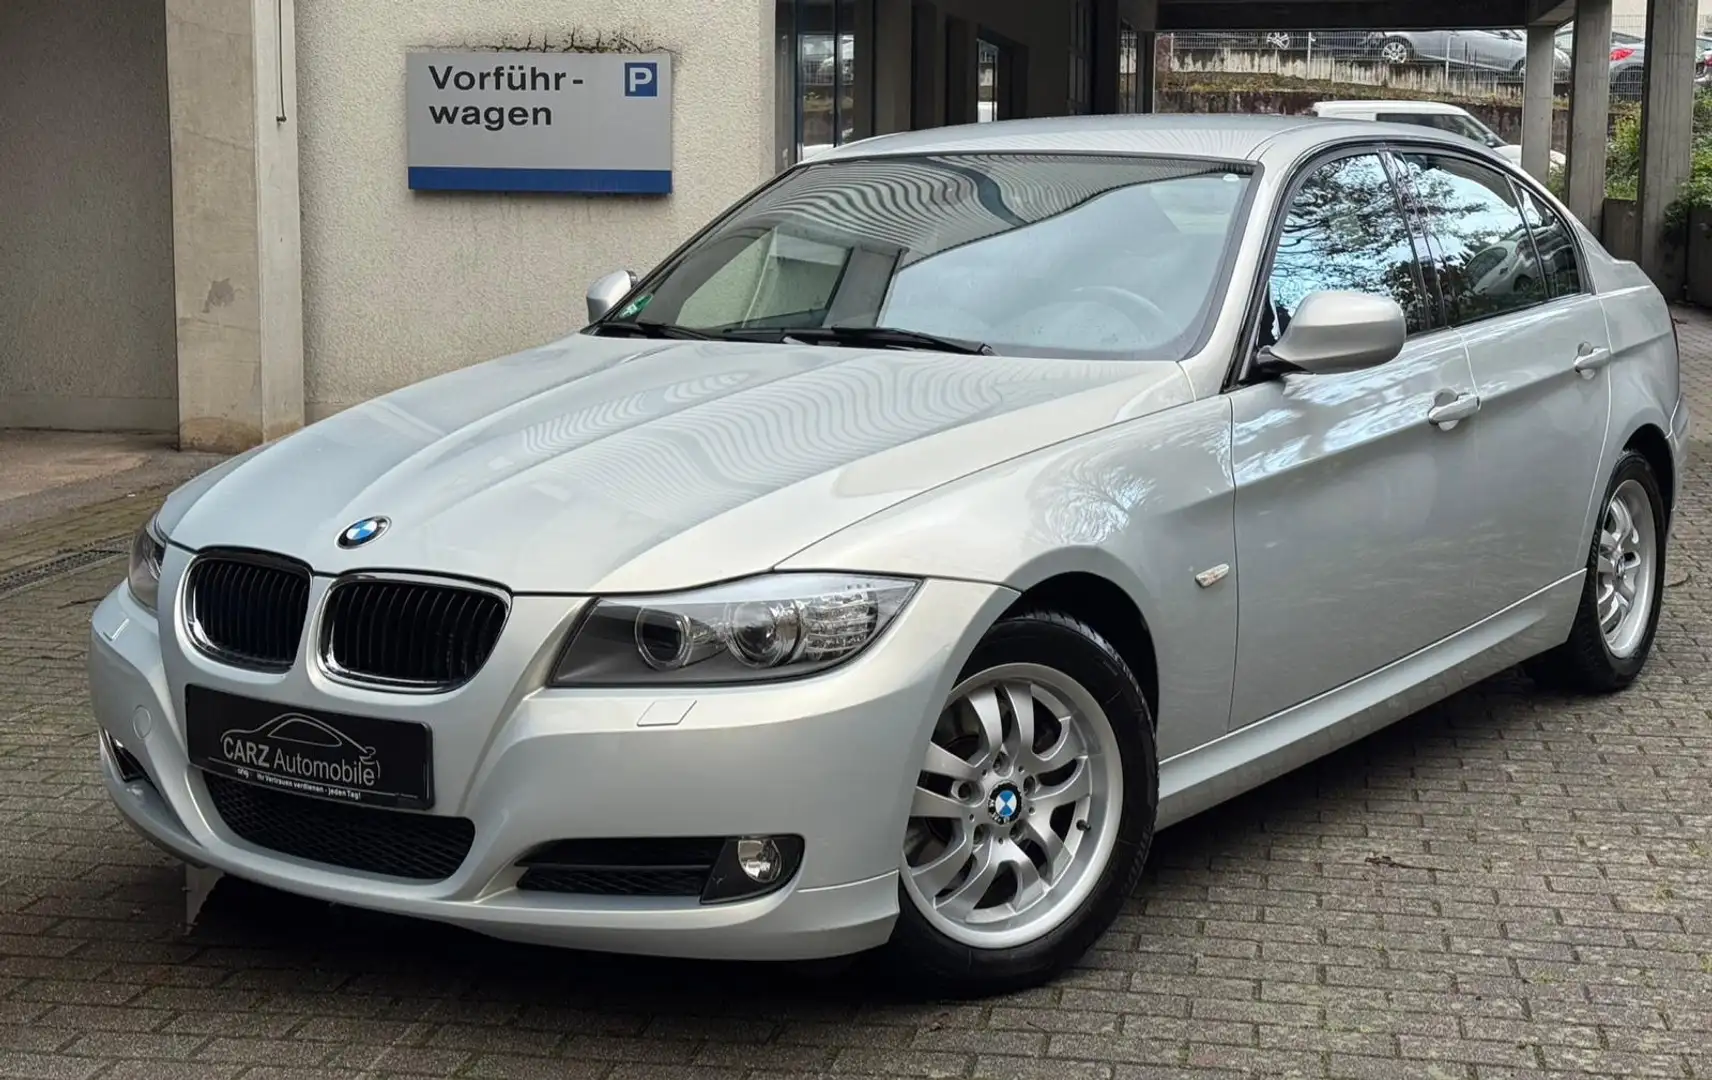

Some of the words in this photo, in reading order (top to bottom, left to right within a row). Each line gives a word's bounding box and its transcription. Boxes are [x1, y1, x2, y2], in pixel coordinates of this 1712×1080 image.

[428, 64, 584, 91] Vorführ-
[628, 67, 653, 93] P
[428, 105, 552, 132] wagen
[222, 736, 270, 768] CARZ
[273, 747, 375, 786] Automobile
